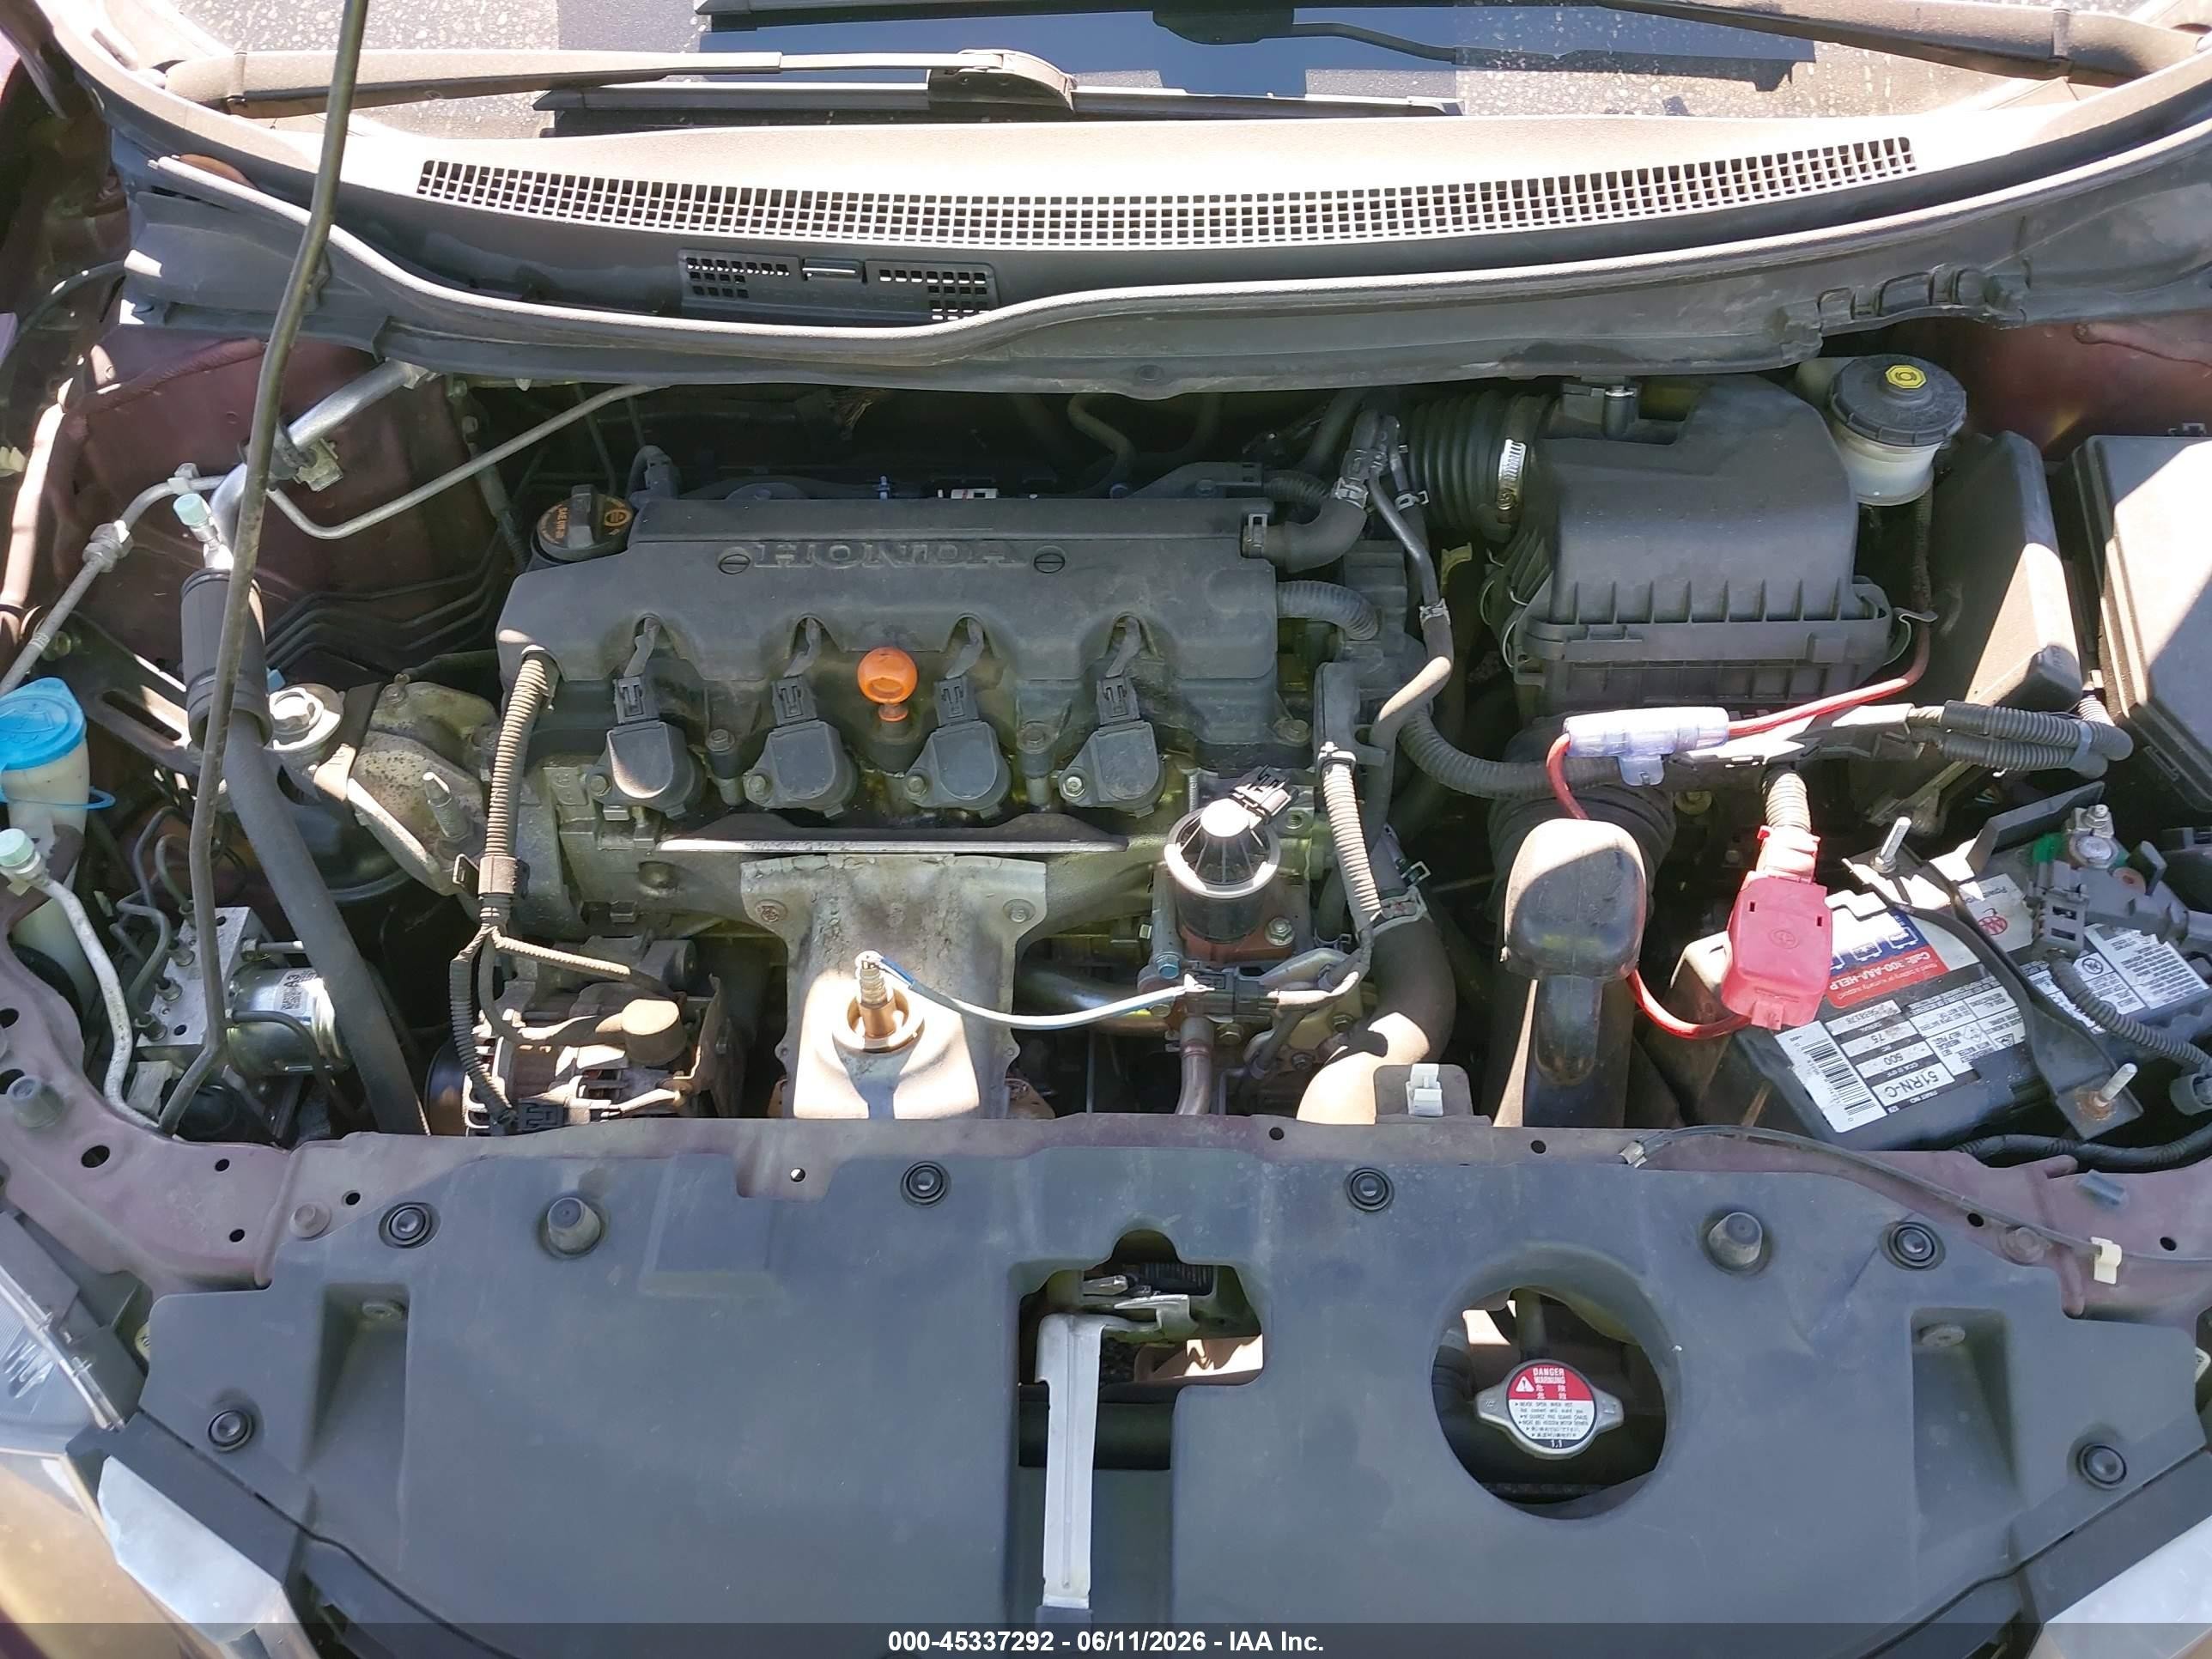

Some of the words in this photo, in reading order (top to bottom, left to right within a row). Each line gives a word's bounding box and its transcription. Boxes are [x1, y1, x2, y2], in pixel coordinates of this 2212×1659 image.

[755, 543, 1029, 568] HONDA
[1905, 951, 1931, 964] Call:
[1870, 1035, 1887, 1045] 75
[1883, 1070, 1941, 1098] 51RN-C
[1533, 1368, 1565, 1376] DANGER
